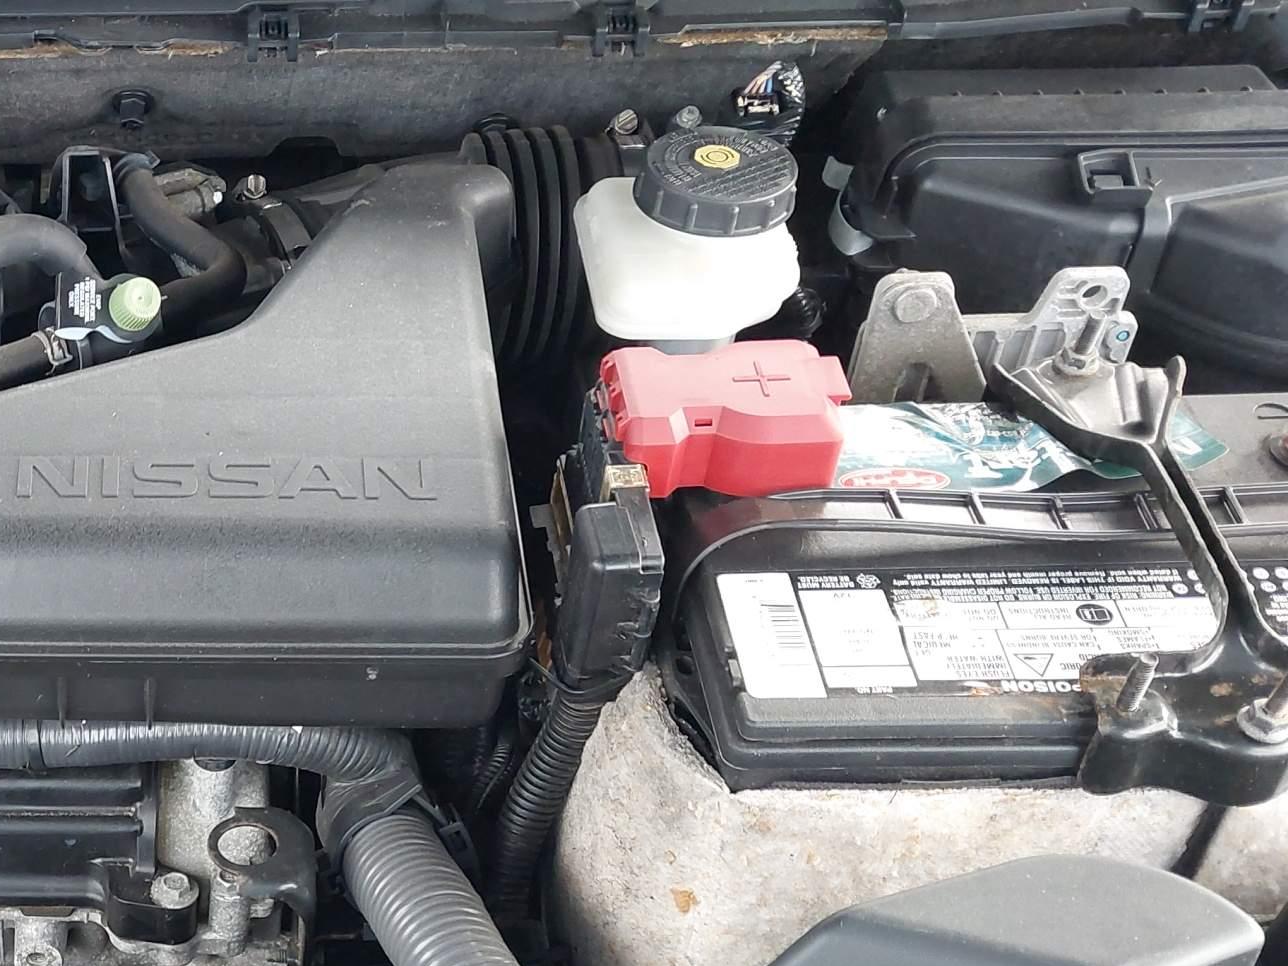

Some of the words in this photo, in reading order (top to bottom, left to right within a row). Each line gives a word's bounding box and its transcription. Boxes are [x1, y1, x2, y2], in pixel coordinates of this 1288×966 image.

[16, 454, 438, 500] NISSAN
[931, 578, 975, 586] WARRANTY
[1000, 680, 1081, 692] POISON
